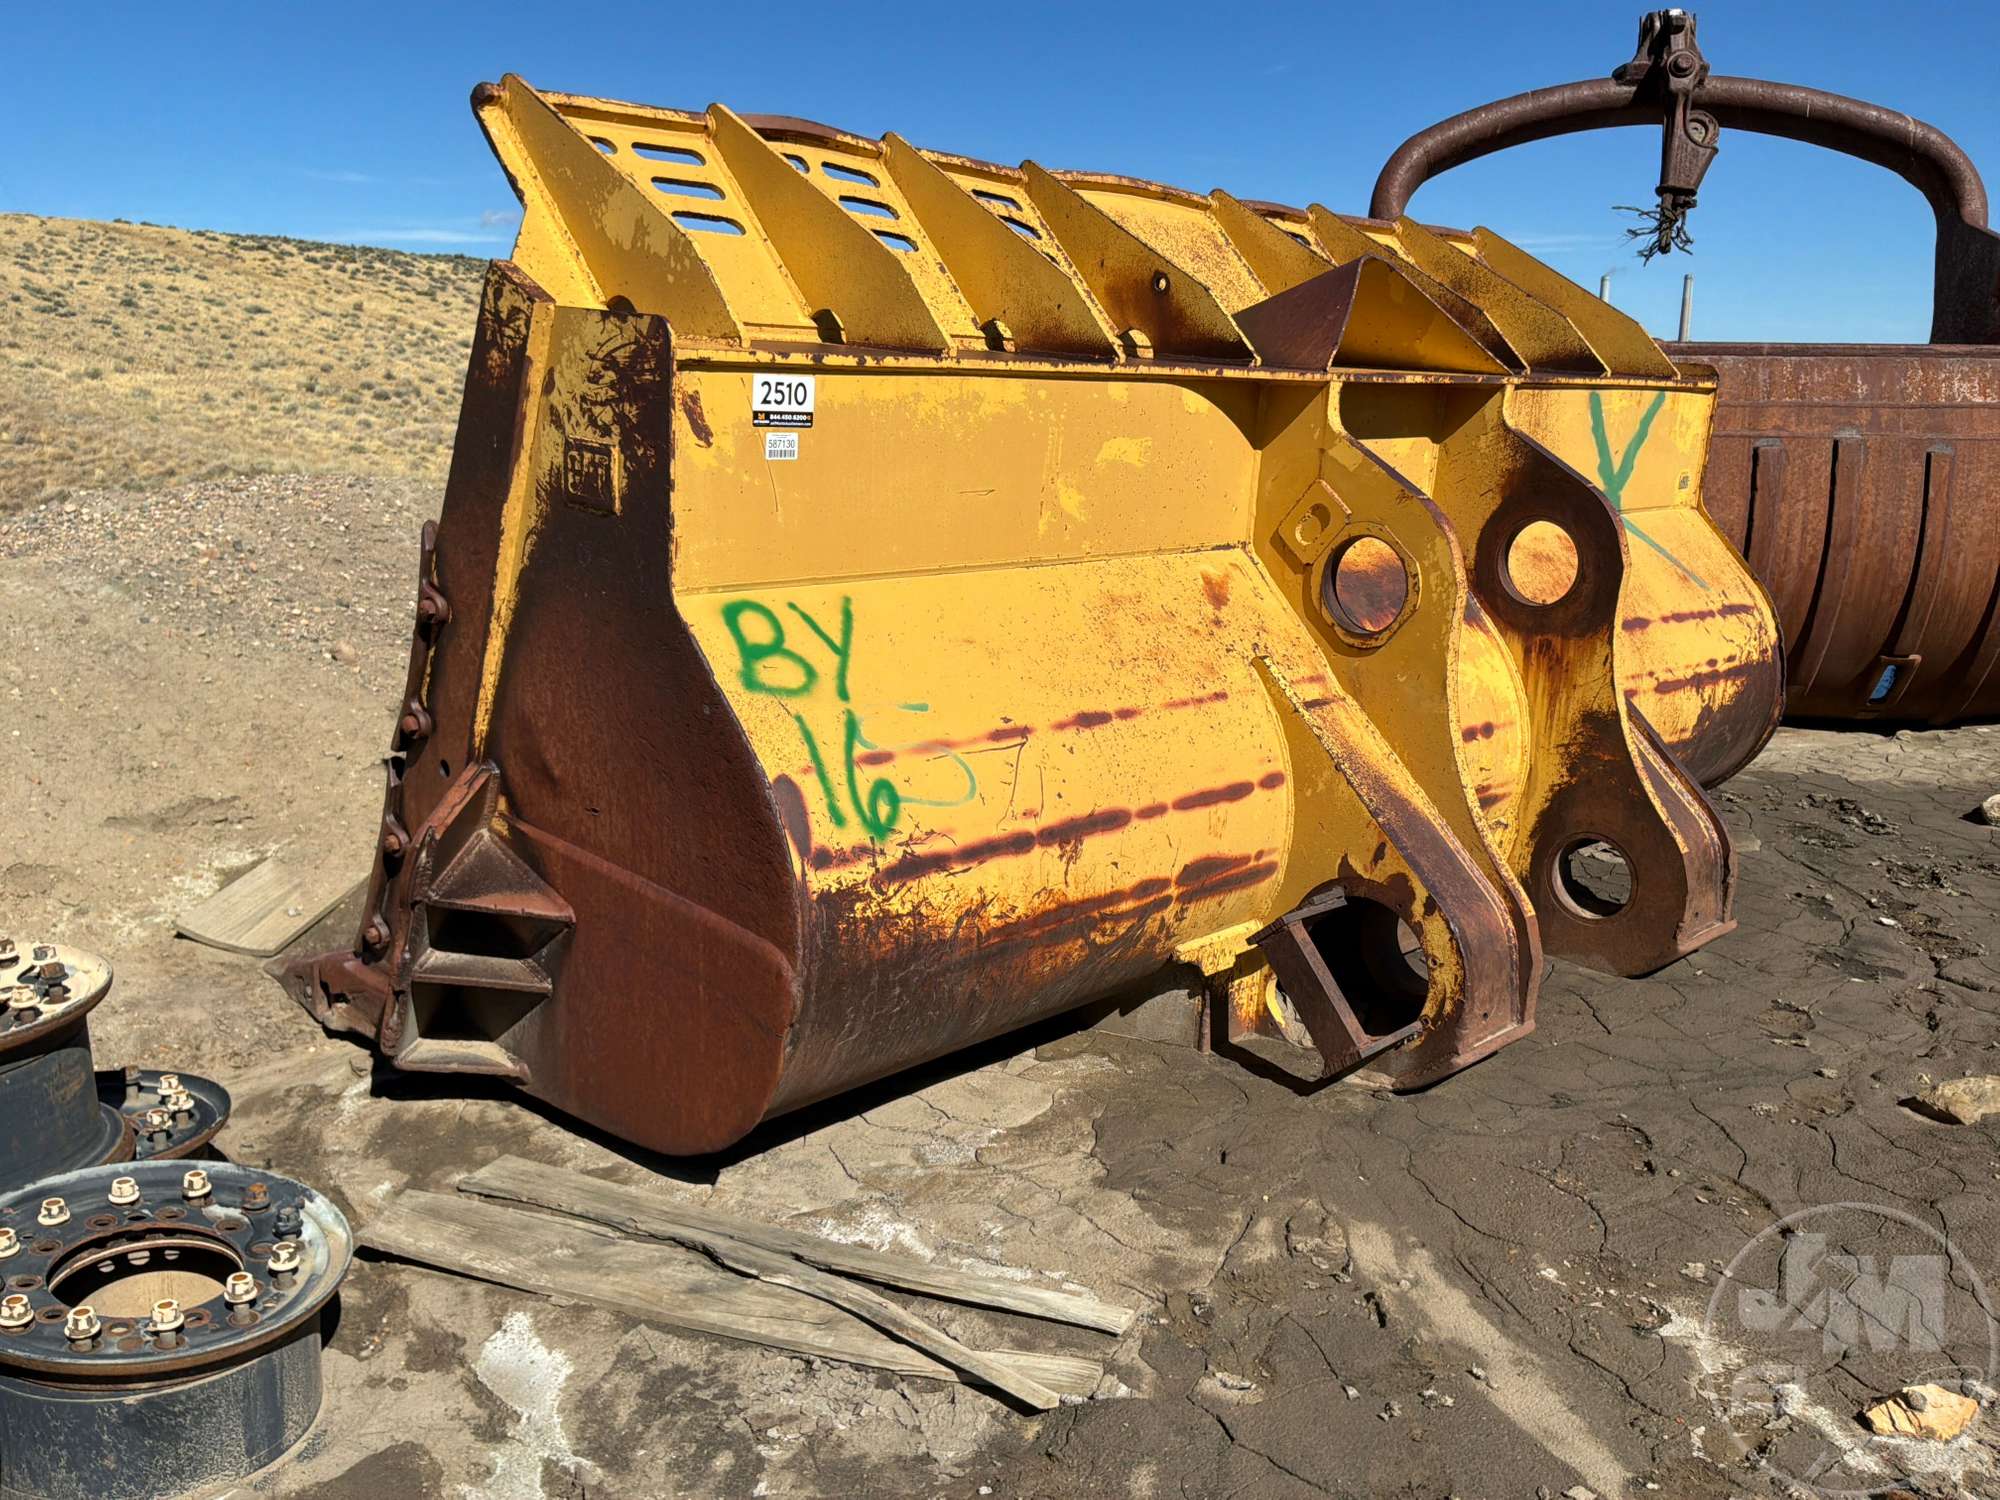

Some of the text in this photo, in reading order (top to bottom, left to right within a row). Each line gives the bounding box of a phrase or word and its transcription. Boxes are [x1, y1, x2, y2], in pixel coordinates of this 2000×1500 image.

[760, 380, 807, 406] 2510
[768, 439, 796, 449] 587130
[722, 596, 853, 703] BY
[794, 707, 901, 842] 16
